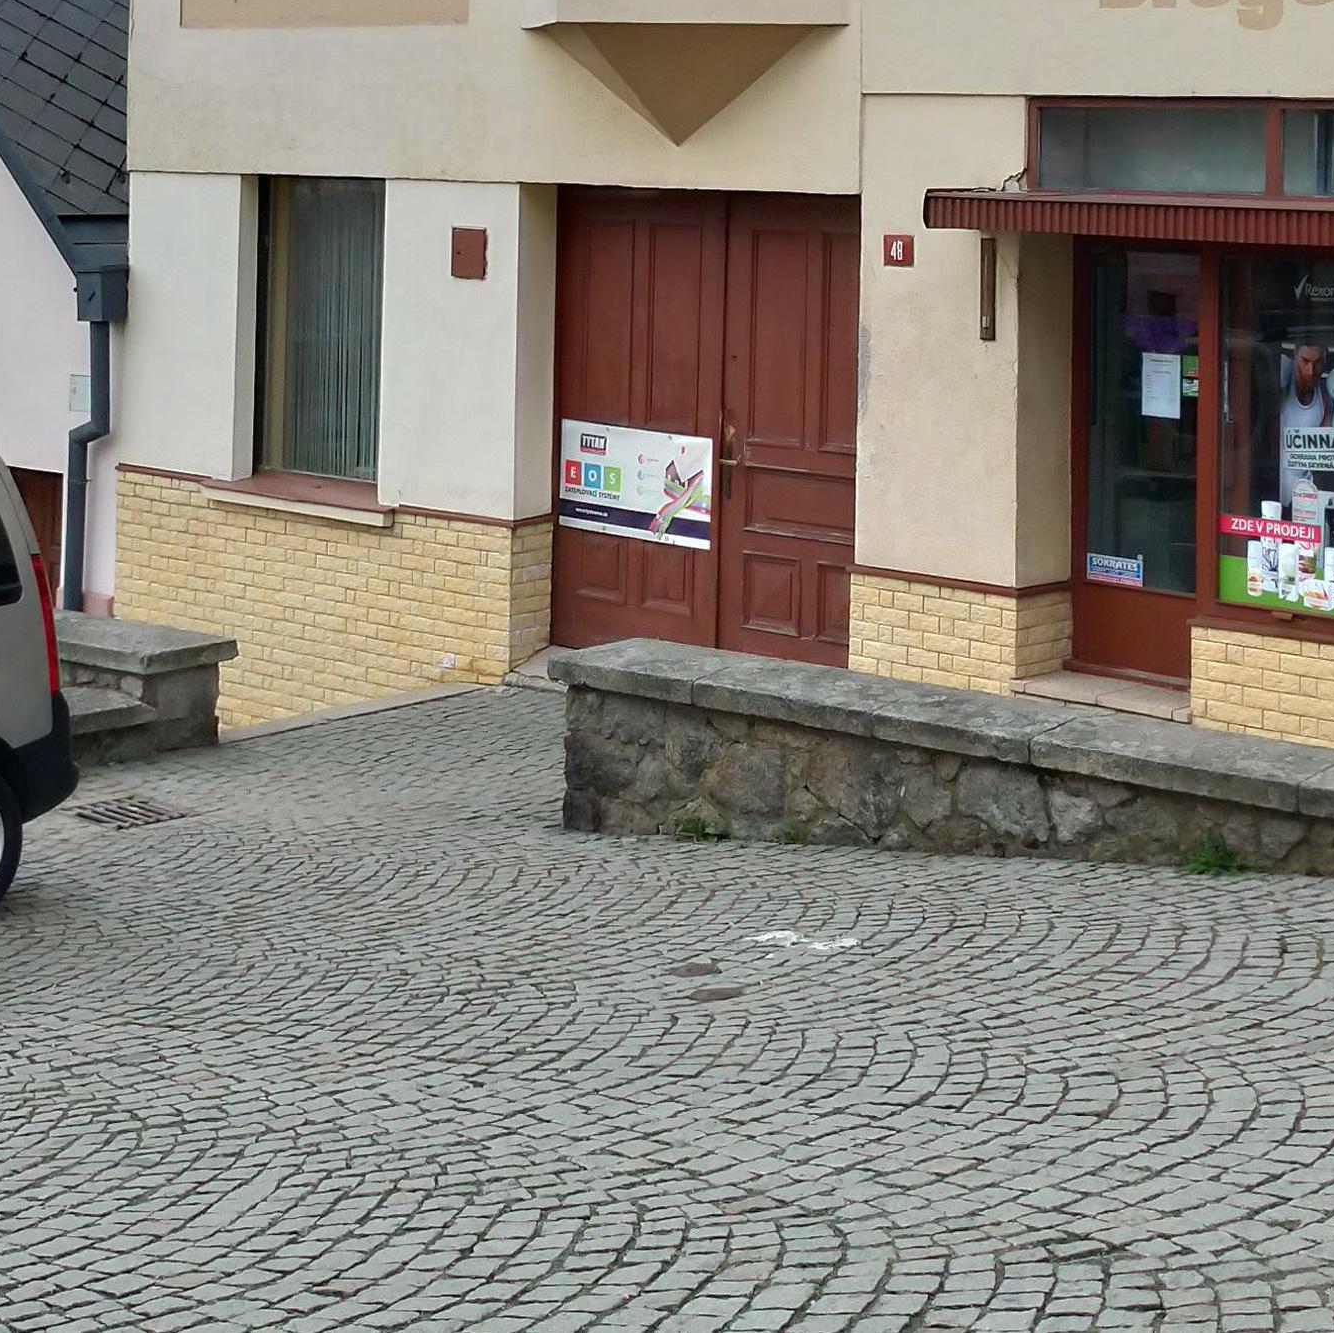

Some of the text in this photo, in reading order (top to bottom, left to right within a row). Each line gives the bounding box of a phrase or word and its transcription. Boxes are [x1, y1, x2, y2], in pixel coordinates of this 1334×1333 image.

[1231, 517, 1316, 540] ZDE V PRODEJI
[1091, 557, 1139, 571] SOKRATES
